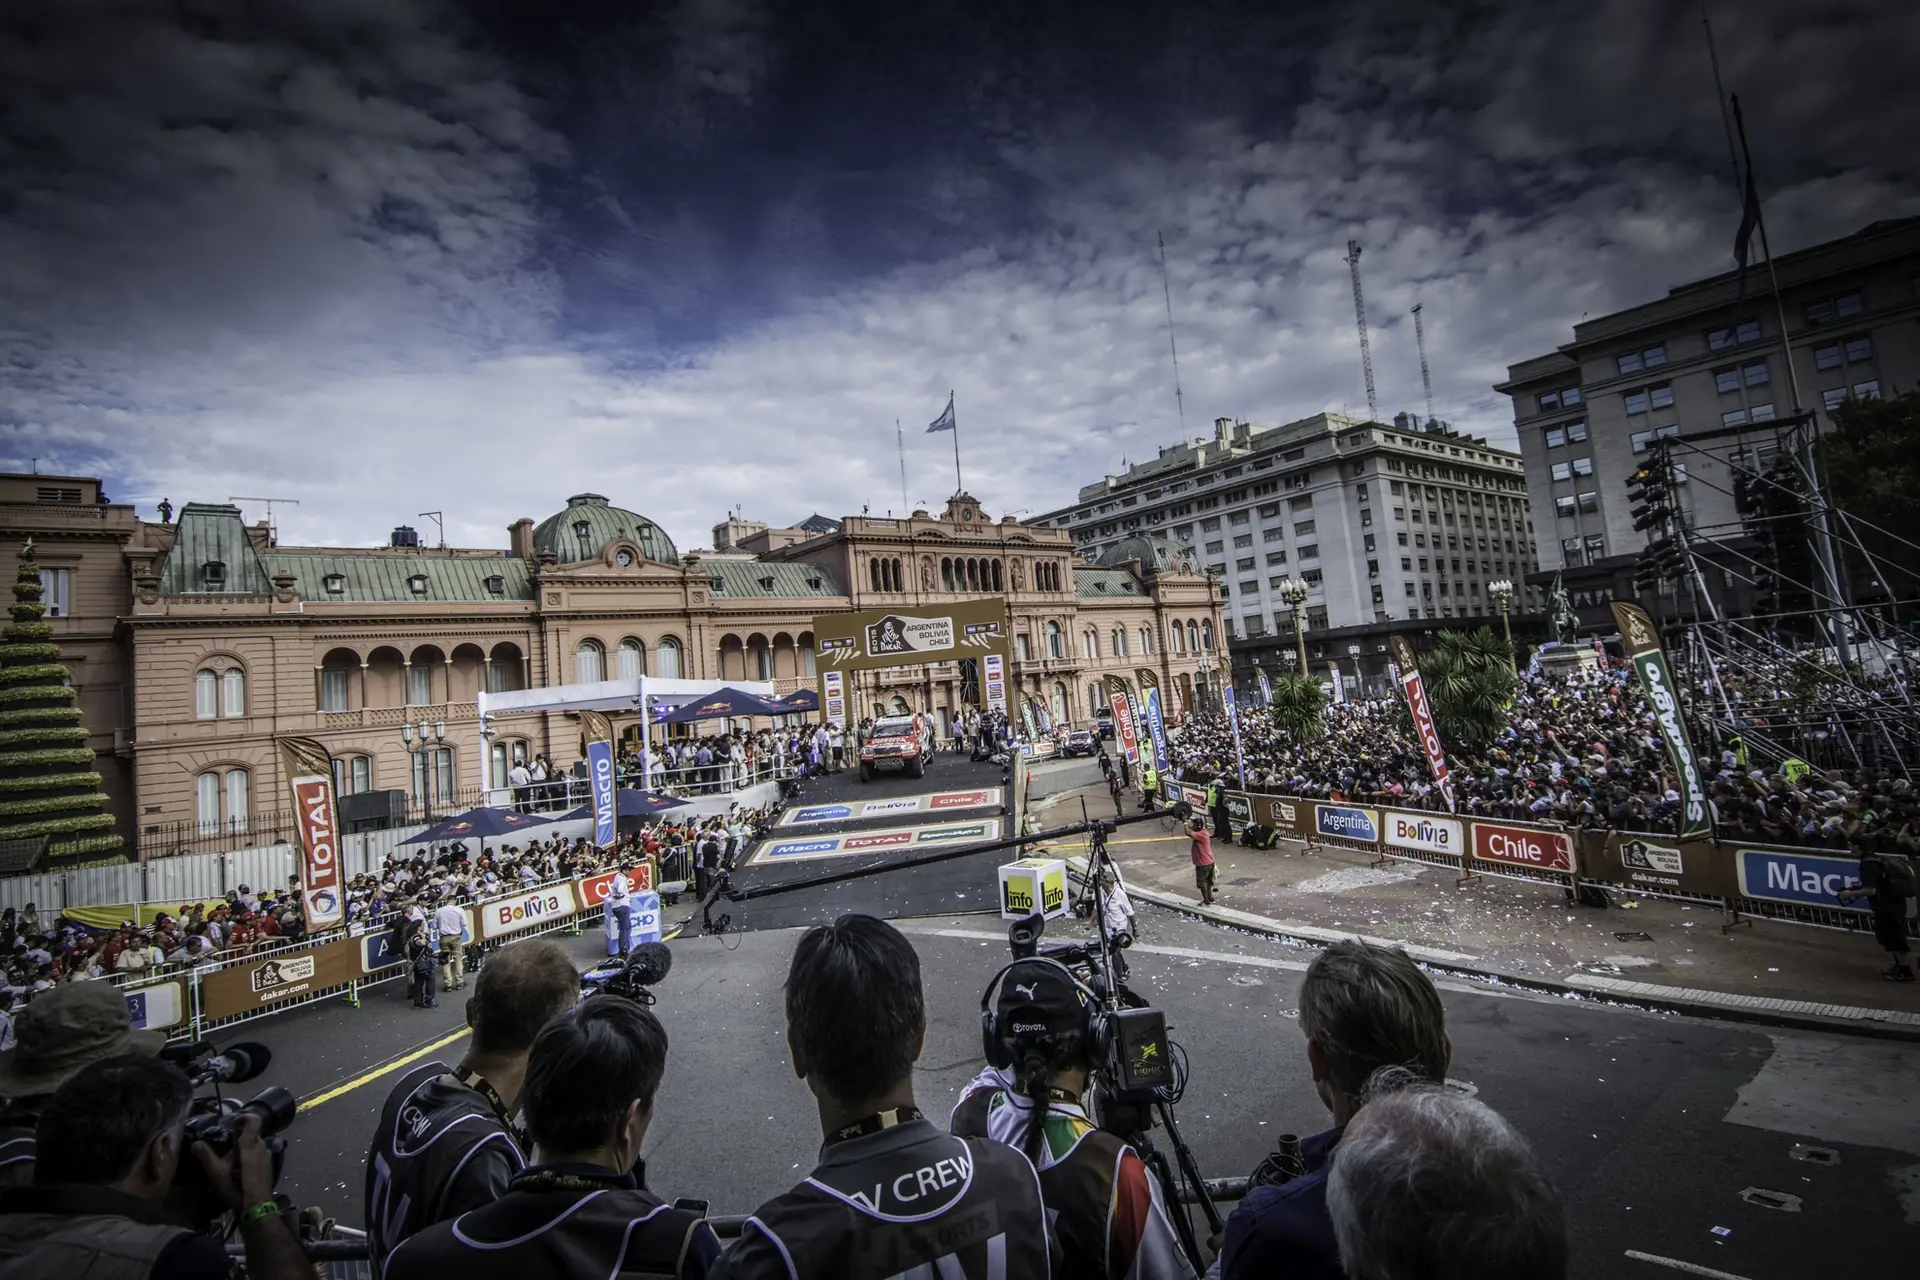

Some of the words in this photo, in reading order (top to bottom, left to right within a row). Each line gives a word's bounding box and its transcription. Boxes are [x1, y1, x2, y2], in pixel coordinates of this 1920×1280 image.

[906, 621, 949, 632] ARGENTINA
[919, 630, 949, 639] BOLIVIA
[929, 638, 950, 646] CHILE
[1120, 709, 1133, 740] Chile
[1149, 706, 1166, 761] Argentina
[1413, 681, 1445, 776] TOTAL
[1645, 662, 1705, 822] SpeedAgro
[596, 758, 612, 826] Macro
[800, 808, 848, 818] Argentina
[866, 800, 916, 811] Bolivia
[939, 796, 973, 804] Chile
[1227, 801, 1248, 816] dAgro
[1323, 811, 1370, 831] Argentina
[307, 785, 332, 886] TOTAL
[1397, 820, 1448, 844] Bolivia
[778, 843, 832, 853] Macro
[848, 836, 909, 846] TOTAL
[1488, 834, 1542, 861] Chile
[1631, 872, 1679, 886] dakar.com
[1767, 861, 1862, 896] Macr
[1009, 891, 1034, 908] info
[1045, 887, 1064, 906] info
[499, 894, 559, 925] Bolivia
[281, 958, 311, 970] ARGENTINA
[290, 965, 312, 974] BOLIVIA
[297, 969, 312, 977] CHILE
[260, 982, 309, 1002] dakar.com
[1022, 1023, 1046, 1032] TOYOTA
[893, 1156, 970, 1202] CREW
